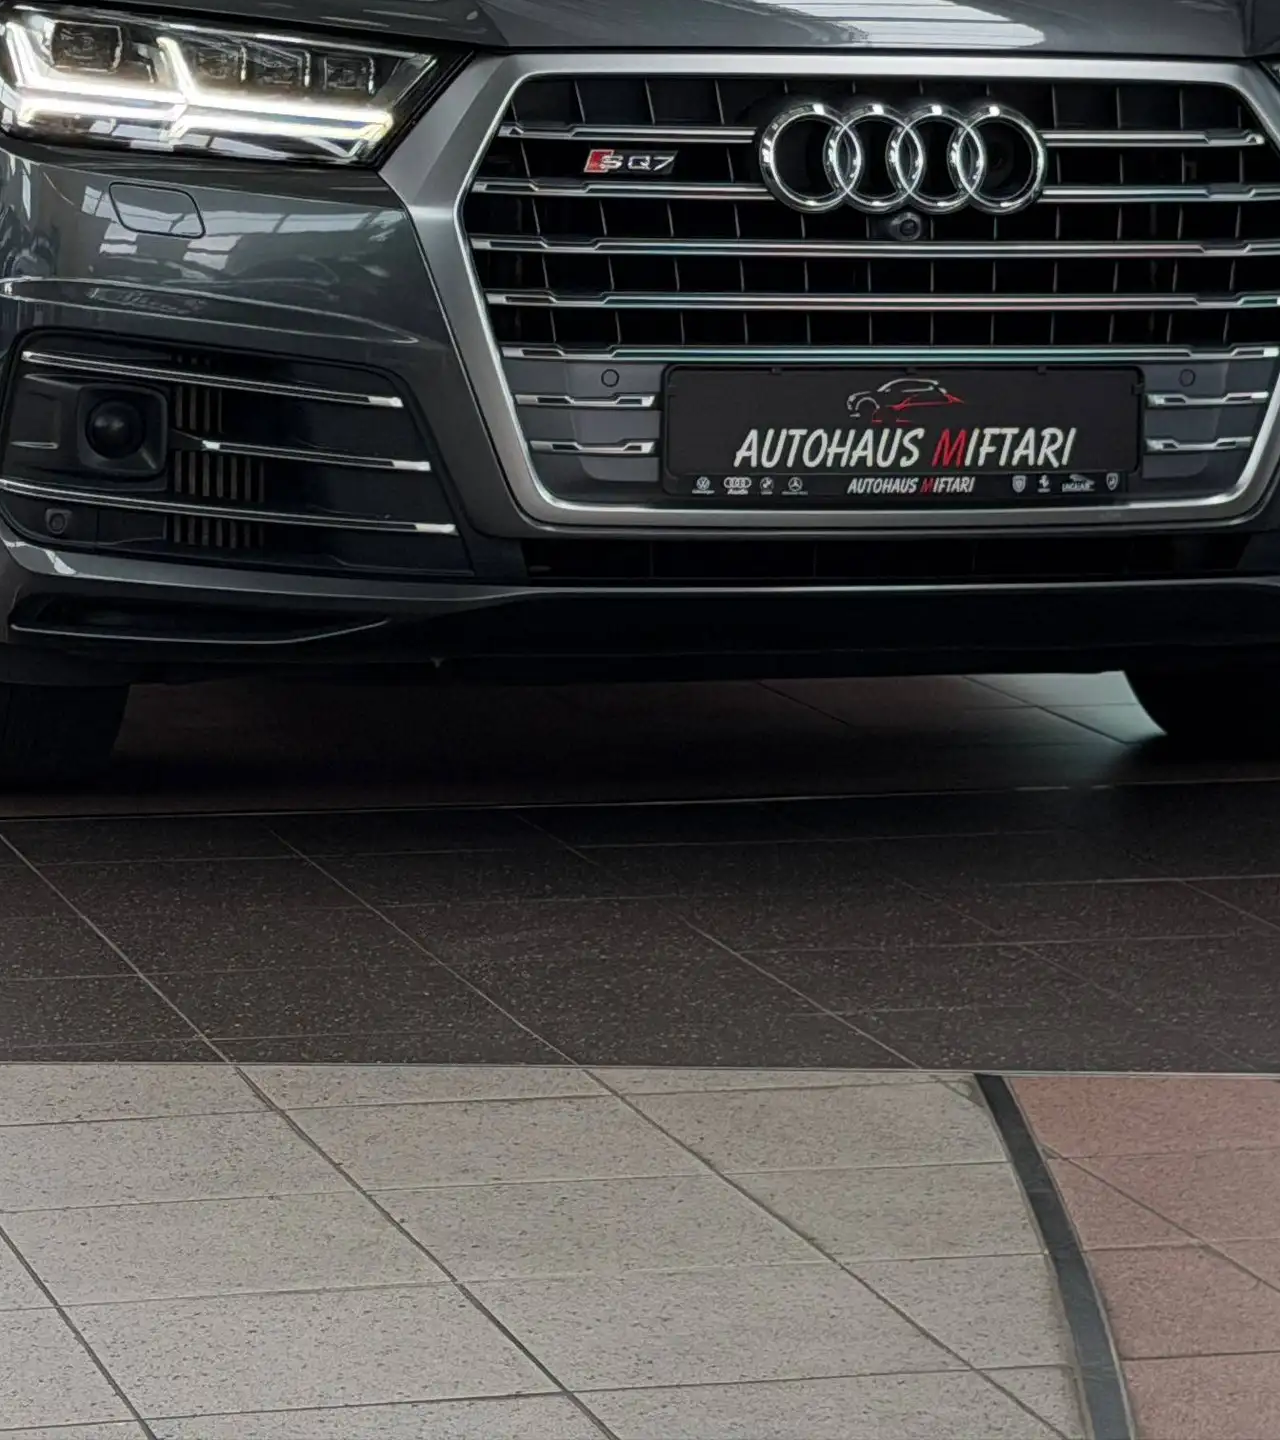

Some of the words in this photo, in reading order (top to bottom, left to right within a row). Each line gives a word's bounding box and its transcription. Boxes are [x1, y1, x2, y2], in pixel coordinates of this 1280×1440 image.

[733, 428, 925, 468] AUTOHAUS
[931, 427, 1077, 468] MIFTARI
[847, 477, 918, 494] AUTOHAUS
[920, 476, 976, 494] MIFTARI
